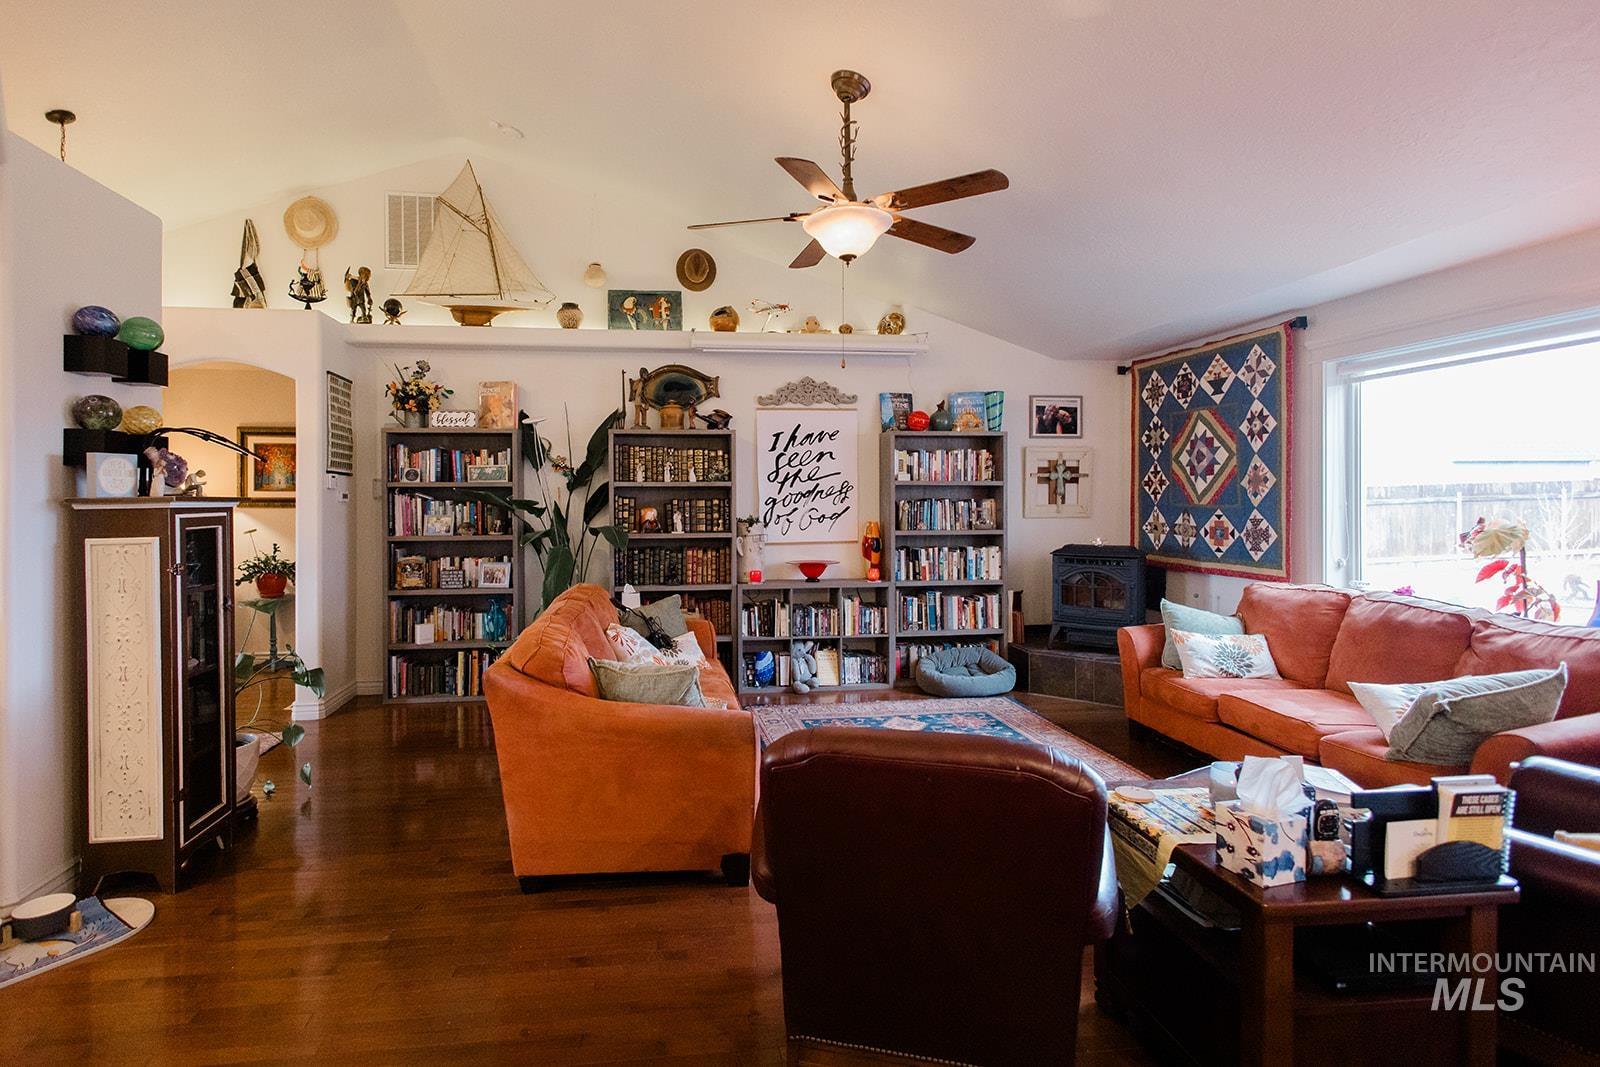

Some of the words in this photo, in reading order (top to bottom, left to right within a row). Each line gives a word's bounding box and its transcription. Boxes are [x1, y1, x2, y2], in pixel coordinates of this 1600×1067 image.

[436, 413, 470, 425] blessed
[768, 431, 784, 452] I
[783, 423, 840, 452] have
[767, 450, 836, 482] seen
[777, 466, 841, 495] the
[763, 480, 854, 528] goodness
[774, 507, 798, 536] of
[799, 506, 850, 532] God
[1485, 804, 1502, 814] OPEN
